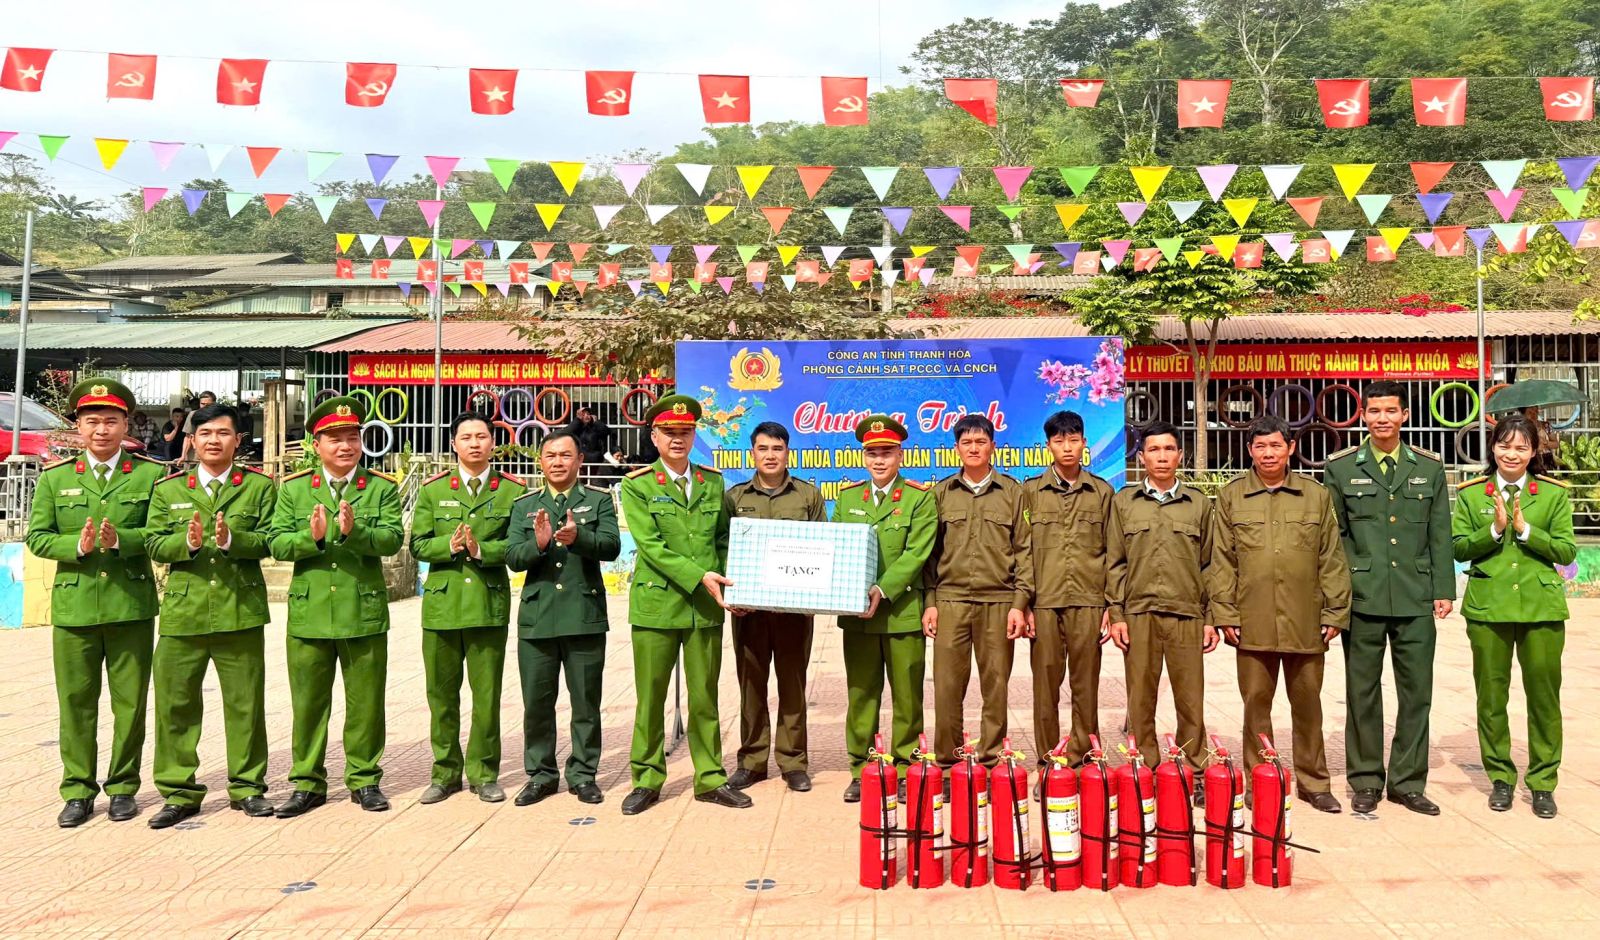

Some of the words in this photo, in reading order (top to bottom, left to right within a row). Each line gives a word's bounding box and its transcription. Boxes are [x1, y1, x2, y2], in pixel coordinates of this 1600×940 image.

[827, 348, 859, 360] CÔNG
[862, 350, 877, 360] AN
[908, 350, 945, 359] THANH
[948, 348, 971, 359] HÓA
[1130, 352, 1143, 373] LÝ
[1211, 355, 1235, 373] KHO
[1238, 351, 1262, 373] BÁU
[1266, 350, 1286, 373] MÀ
[1290, 352, 1321, 376] THỰC
[1325, 350, 1359, 372] HÀNH
[1363, 350, 1378, 372] LÀ
[1382, 350, 1412, 372] CHÌA
[1416, 349, 1450, 372] KHÓA
[374, 360, 396, 378] SÁCH
[398, 360, 409, 378] LÀ
[411, 362, 435, 382] NGỌN
[457, 360, 480, 378] SÁNG
[482, 358, 499, 379] BẤT
[501, 359, 519, 382] DIỆT
[522, 356, 542, 379] CỦA
[543, 361, 555, 382] SỰ
[803, 362, 844, 374] PHÒNG
[847, 361, 880, 374] CẢNH
[883, 362, 905, 374] SÁT
[909, 364, 941, 374] PCCC
[945, 361, 960, 373] VÀ
[964, 363, 997, 373] CNCH
[712, 445, 742, 469] TÌNH
[802, 445, 831, 469] MÙA
[835, 445, 864, 469] ĐÔN
[900, 445, 930, 468] UÂN
[1024, 443, 1054, 467] NĂM
